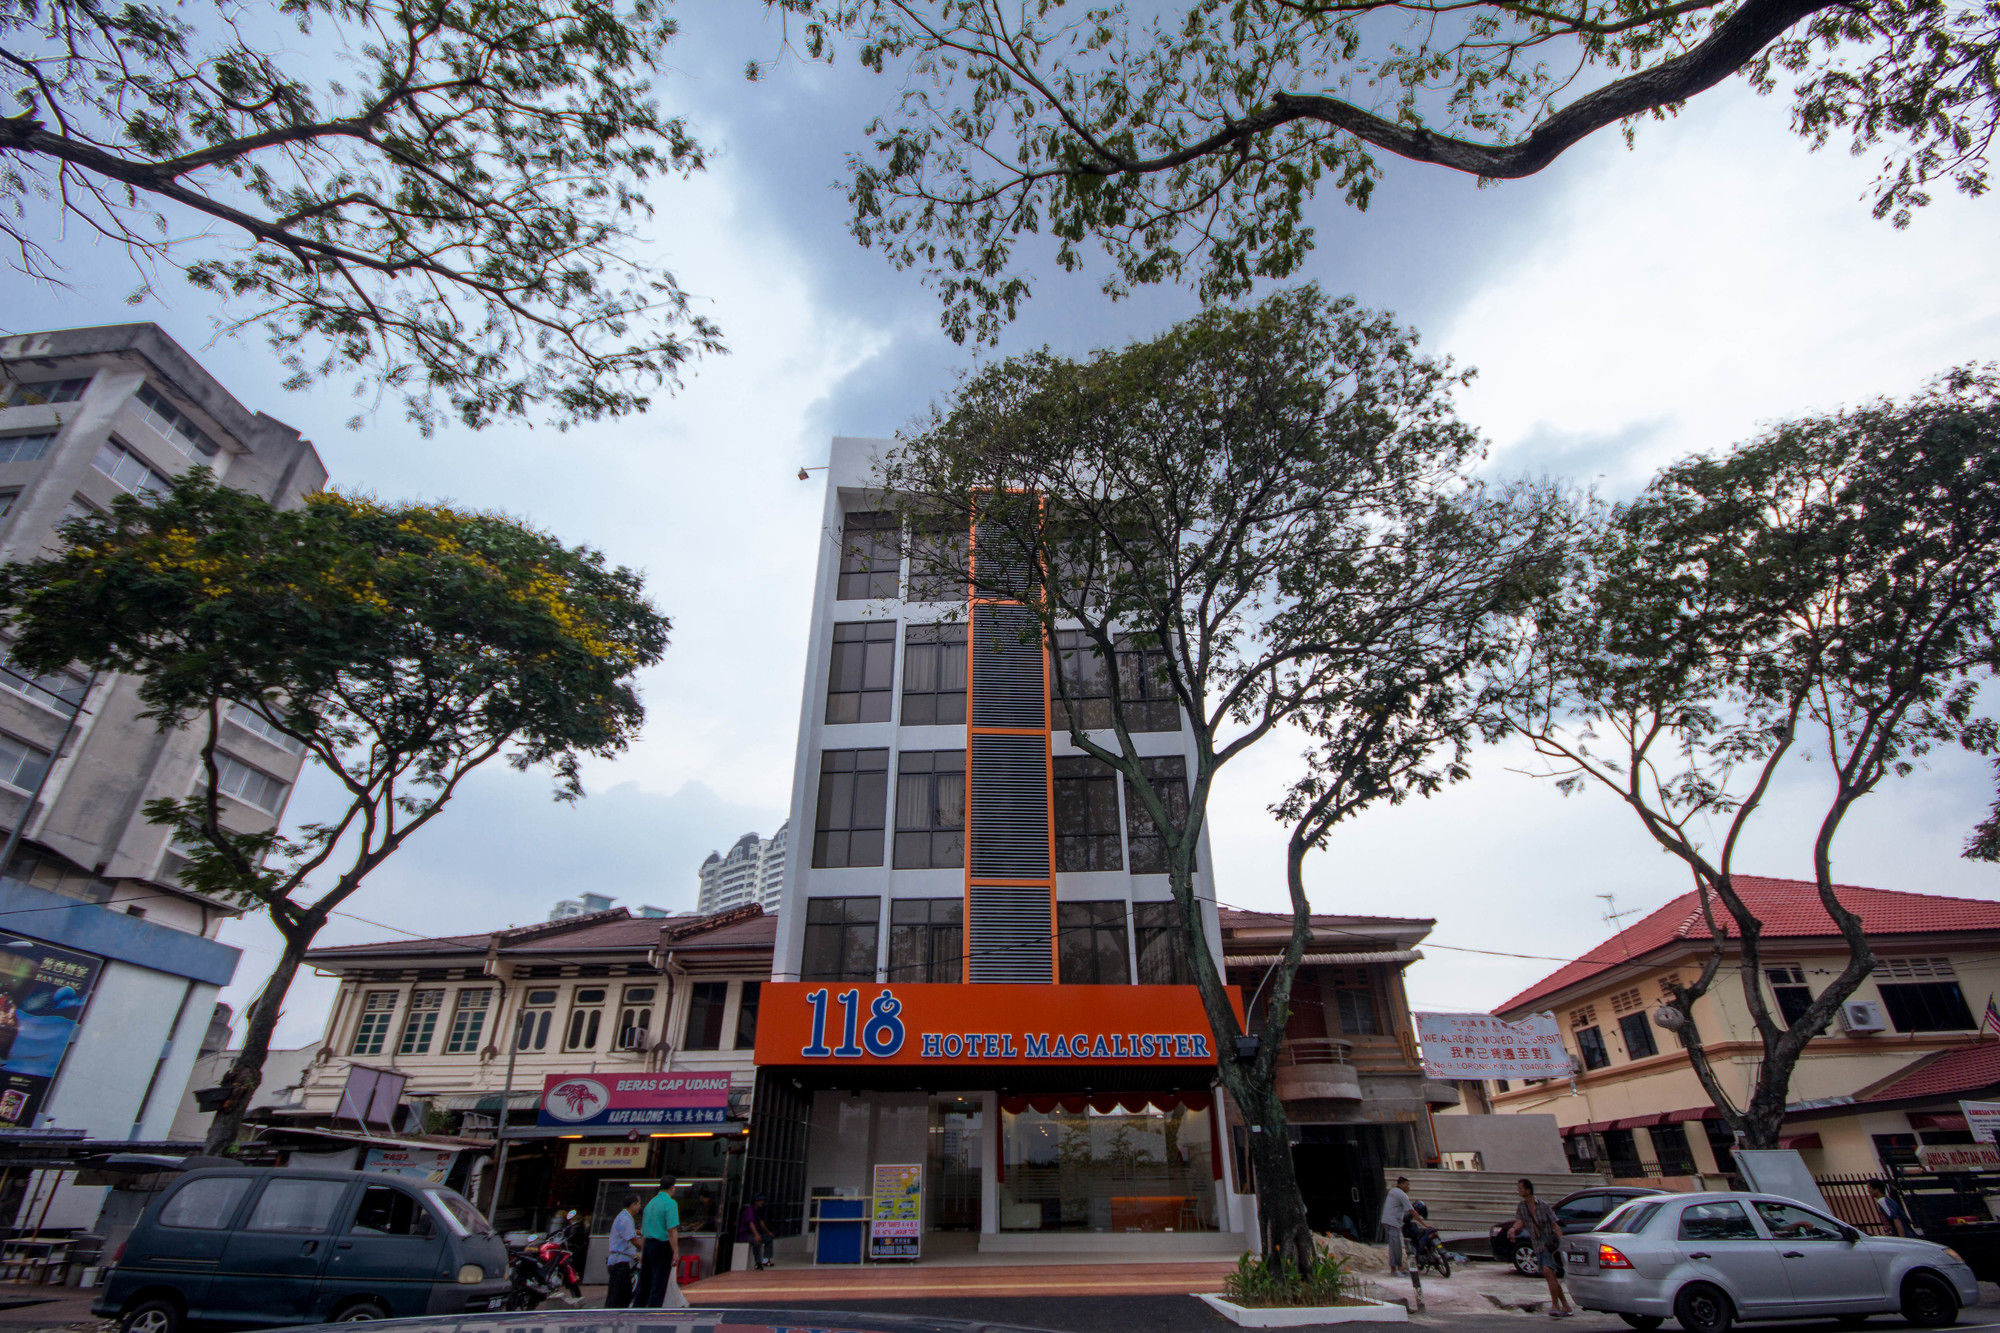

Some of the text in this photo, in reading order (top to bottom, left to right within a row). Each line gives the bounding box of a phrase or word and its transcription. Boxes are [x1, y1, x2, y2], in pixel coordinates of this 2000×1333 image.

[801, 988, 906, 1058] 118
[921, 1033, 1210, 1058] HOTEL MACALISTER
[616, 1079, 728, 1091] BERAS CAP UDANG
